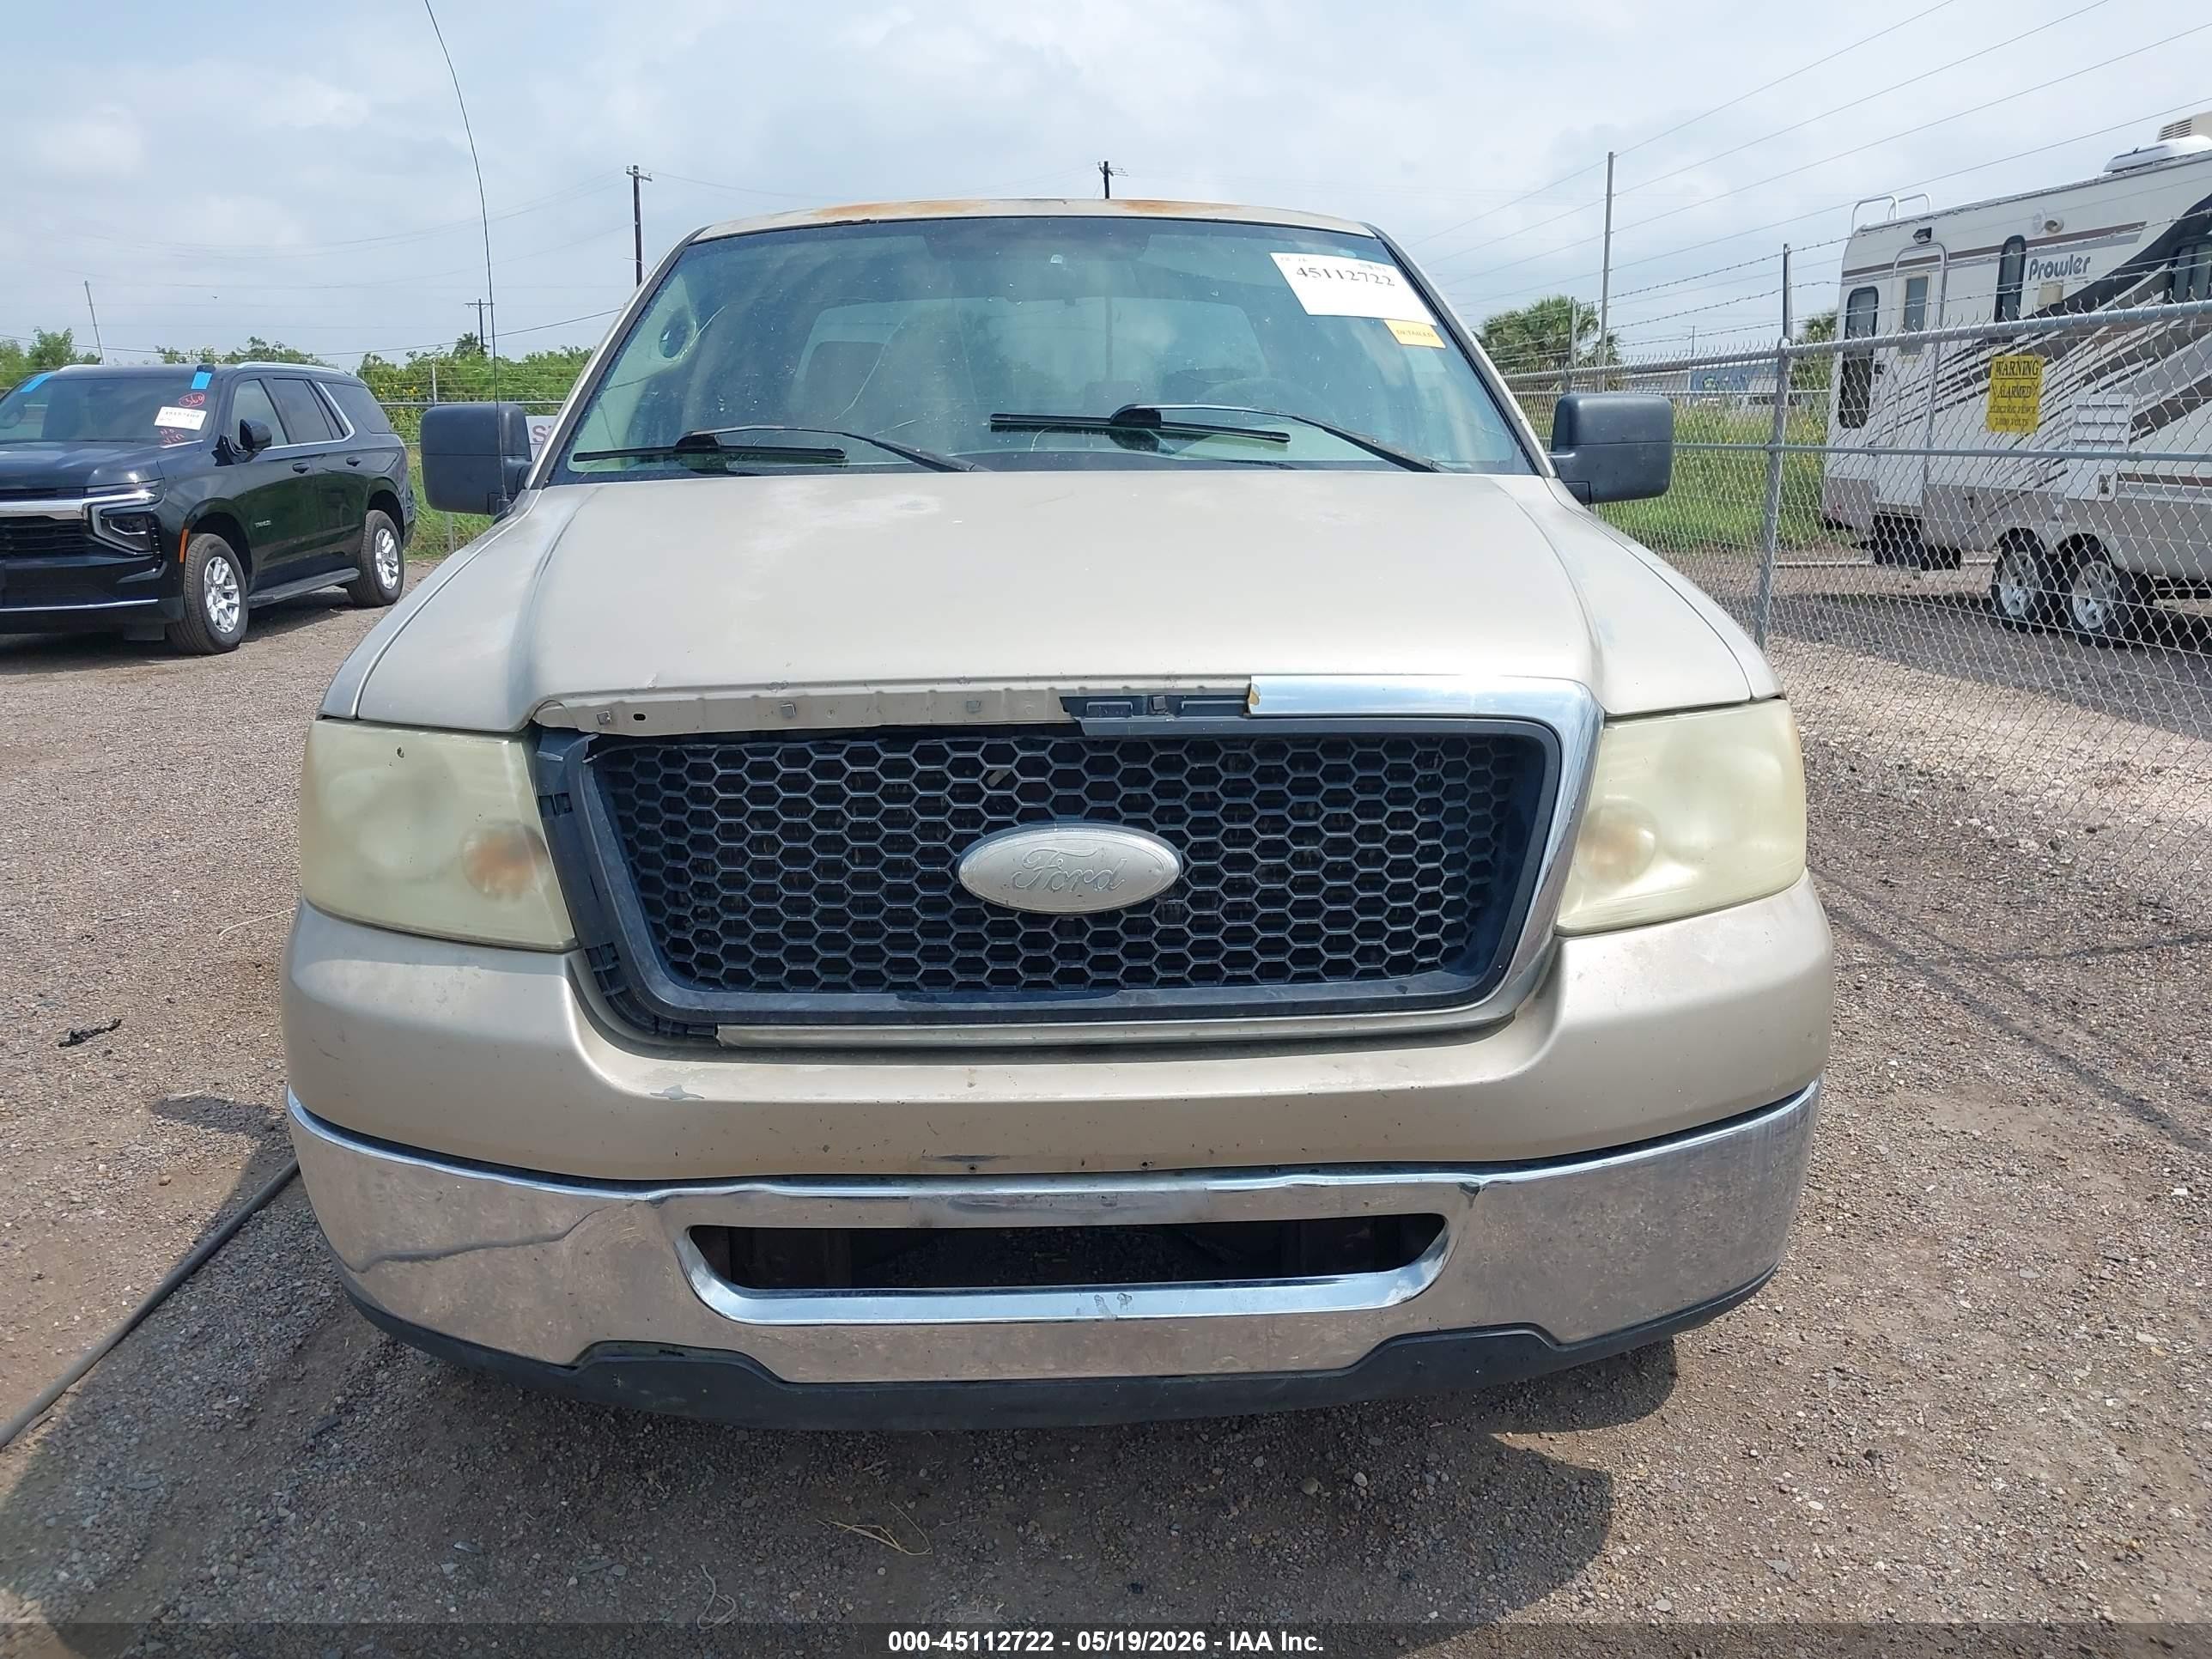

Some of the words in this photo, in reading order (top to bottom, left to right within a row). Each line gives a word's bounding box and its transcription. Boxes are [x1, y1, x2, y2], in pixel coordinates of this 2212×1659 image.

[1297, 267, 1395, 287] 45112722
[2028, 254, 2091, 281] Prowler
[1996, 359, 2039, 376] WARNING
[1997, 384, 2033, 398] ALARMED
[1011, 848, 1127, 892] Ford
